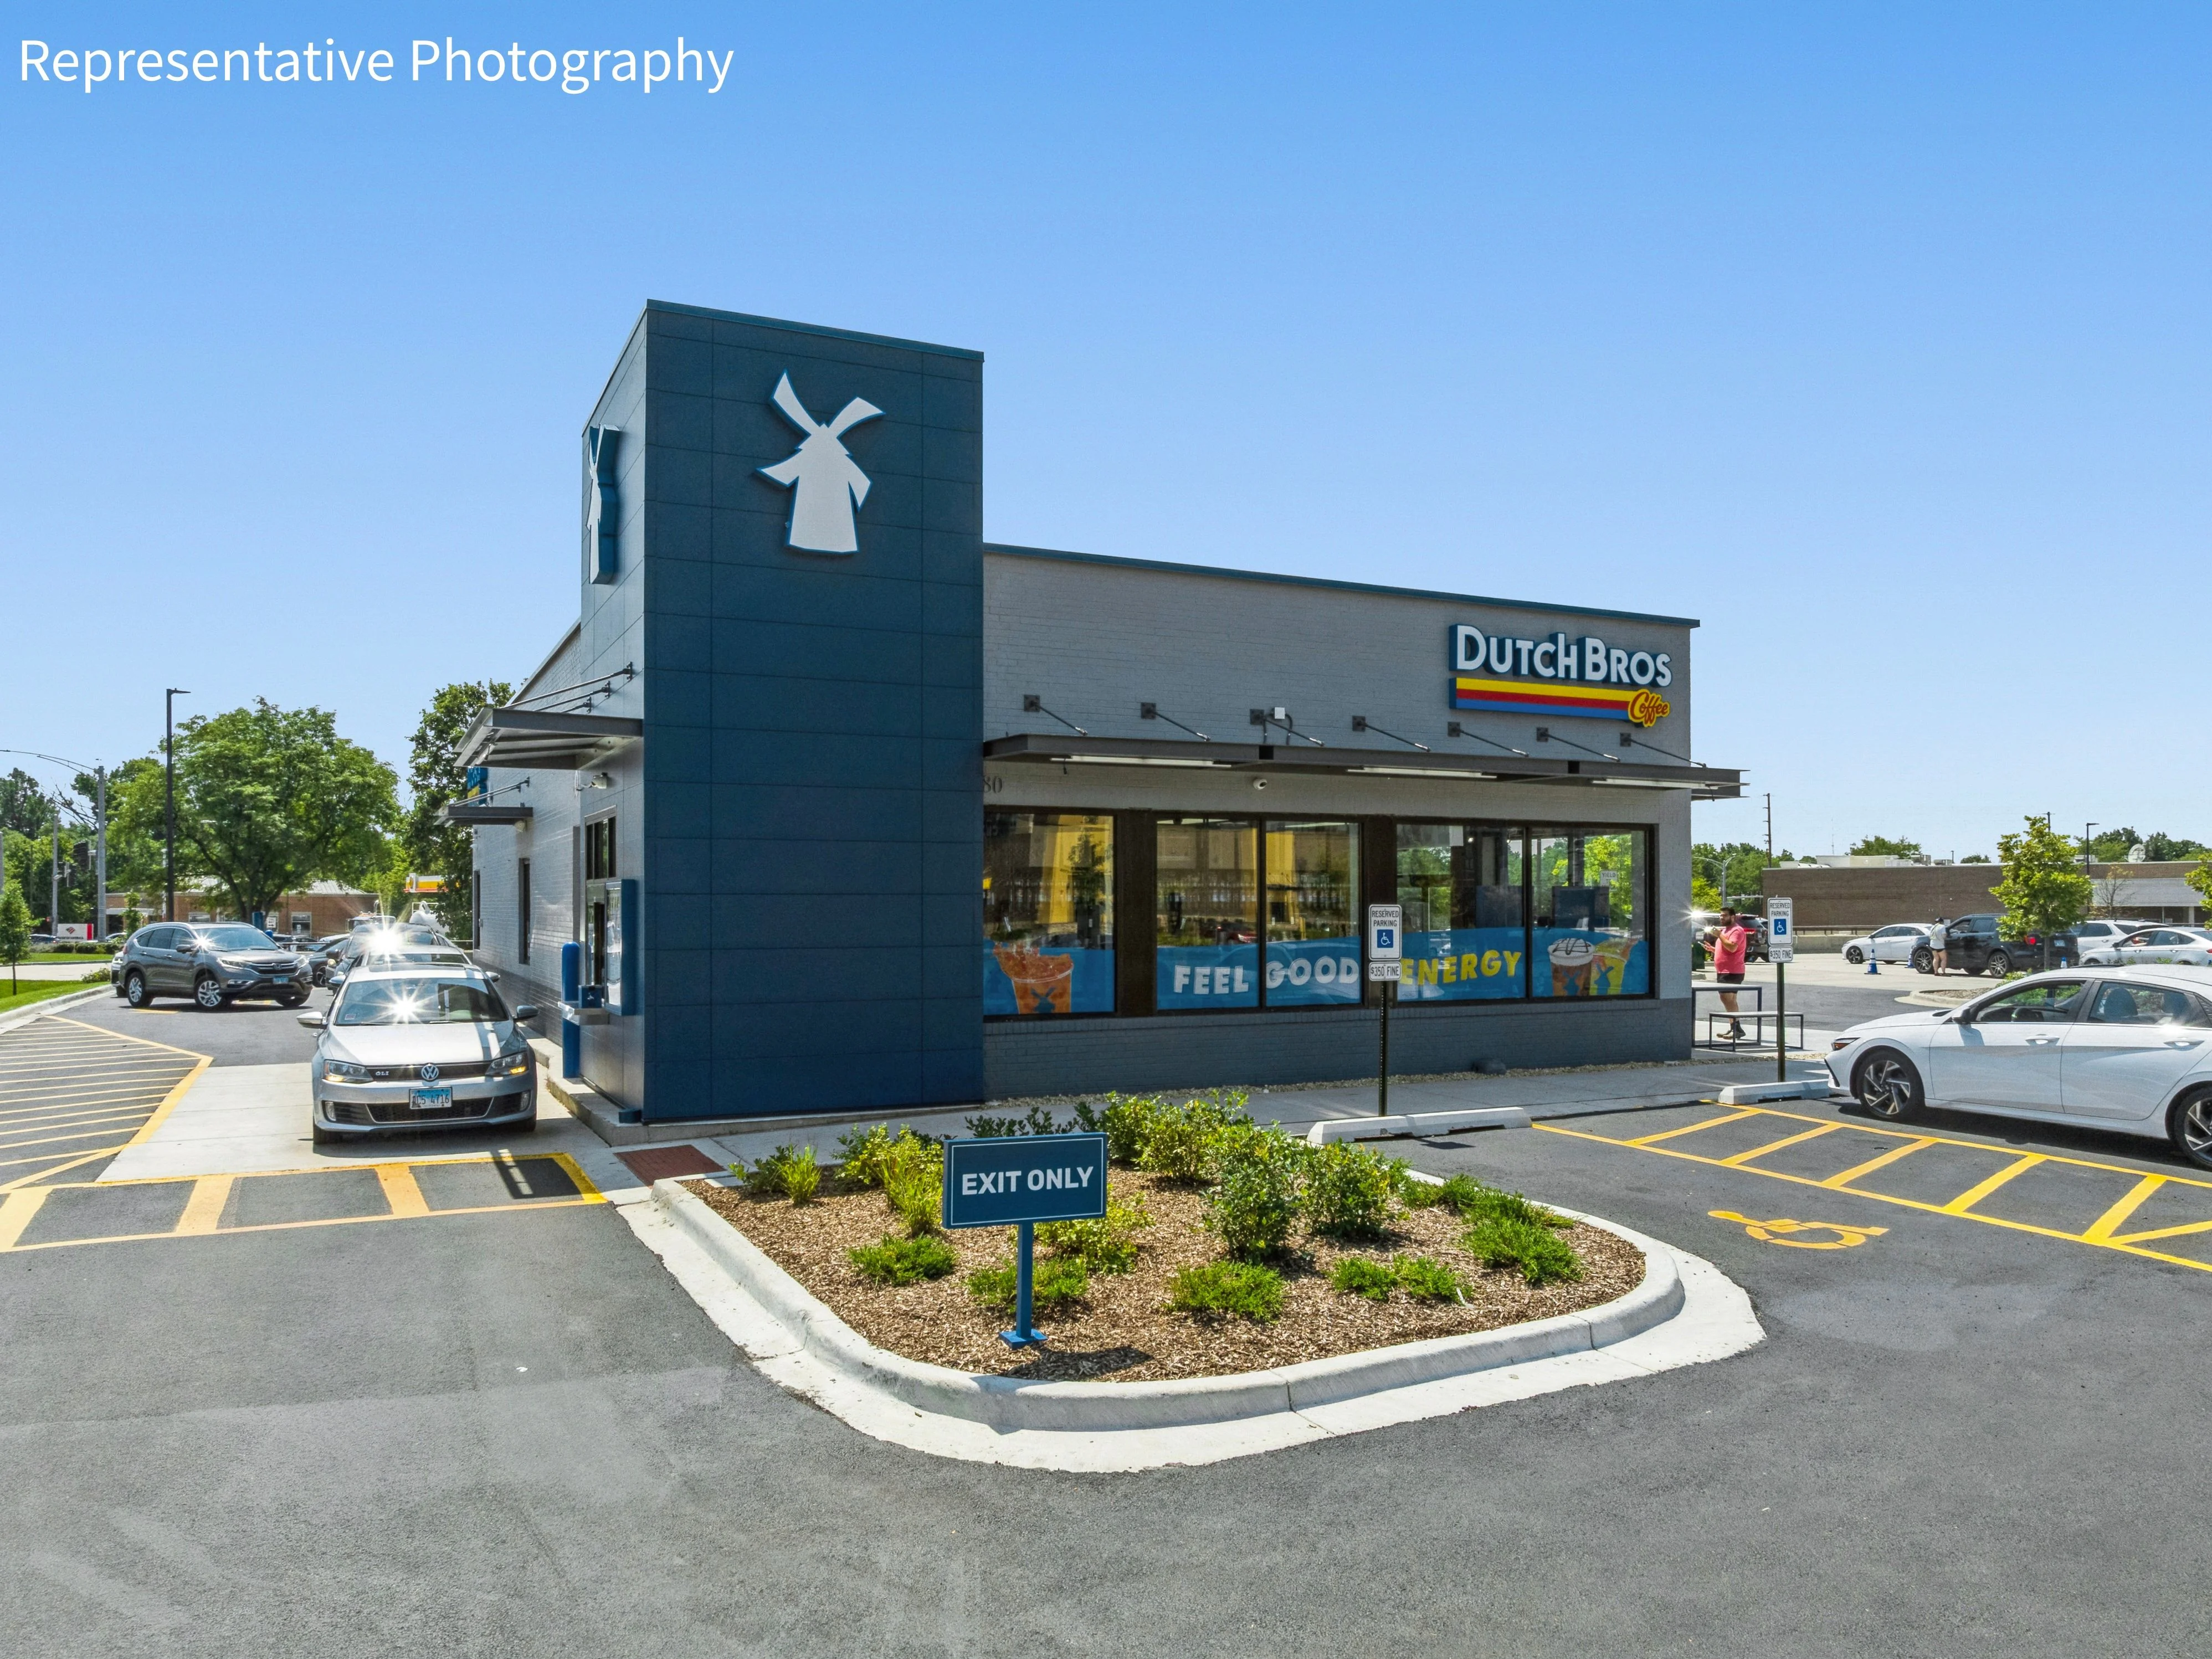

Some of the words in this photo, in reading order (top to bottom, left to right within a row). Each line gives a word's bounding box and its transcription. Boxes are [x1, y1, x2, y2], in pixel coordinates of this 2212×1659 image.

[1584, 637, 1672, 687] BROS
[1630, 691, 1669, 724] Coffee
[1770, 950, 1780, 959] $350
[1782, 950, 1792, 958] FINE
[1173, 965, 1249, 995] FEEL
[1266, 956, 1359, 989] GOOD
[1399, 949, 1522, 985] ENERGY
[1371, 967, 1385, 977] $350
[1387, 966, 1399, 975] FINE
[430, 1094, 449, 1104] 4716
[962, 1170, 1022, 1195] EXIT
[1027, 1166, 1094, 1191] ONLY
